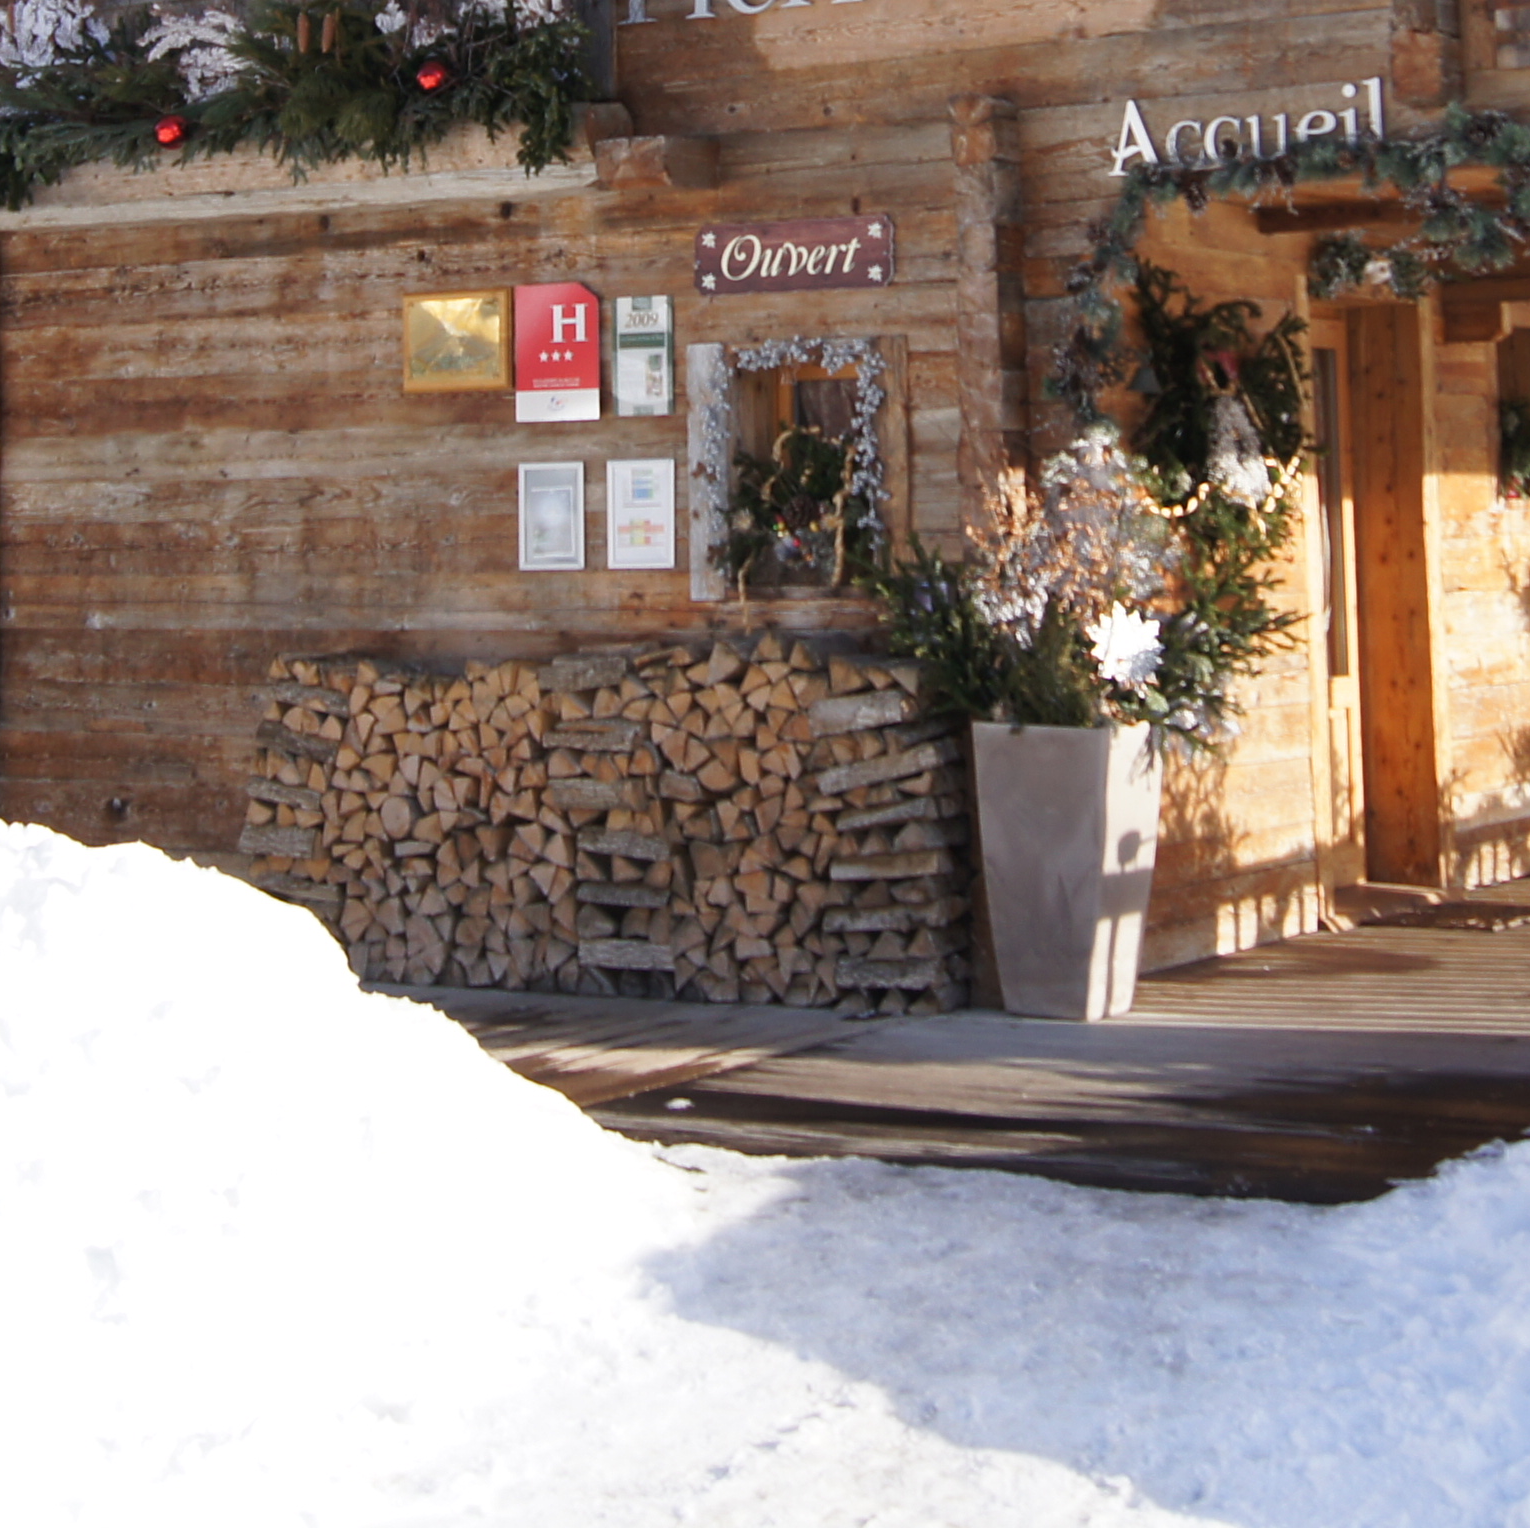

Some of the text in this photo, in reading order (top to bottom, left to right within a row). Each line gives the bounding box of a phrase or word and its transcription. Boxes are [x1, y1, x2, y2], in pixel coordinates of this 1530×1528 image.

[1108, 76, 1383, 177] Accueil
[720, 233, 862, 282] Ouvert
[550, 303, 589, 344] H
[624, 312, 659, 329] 2009
